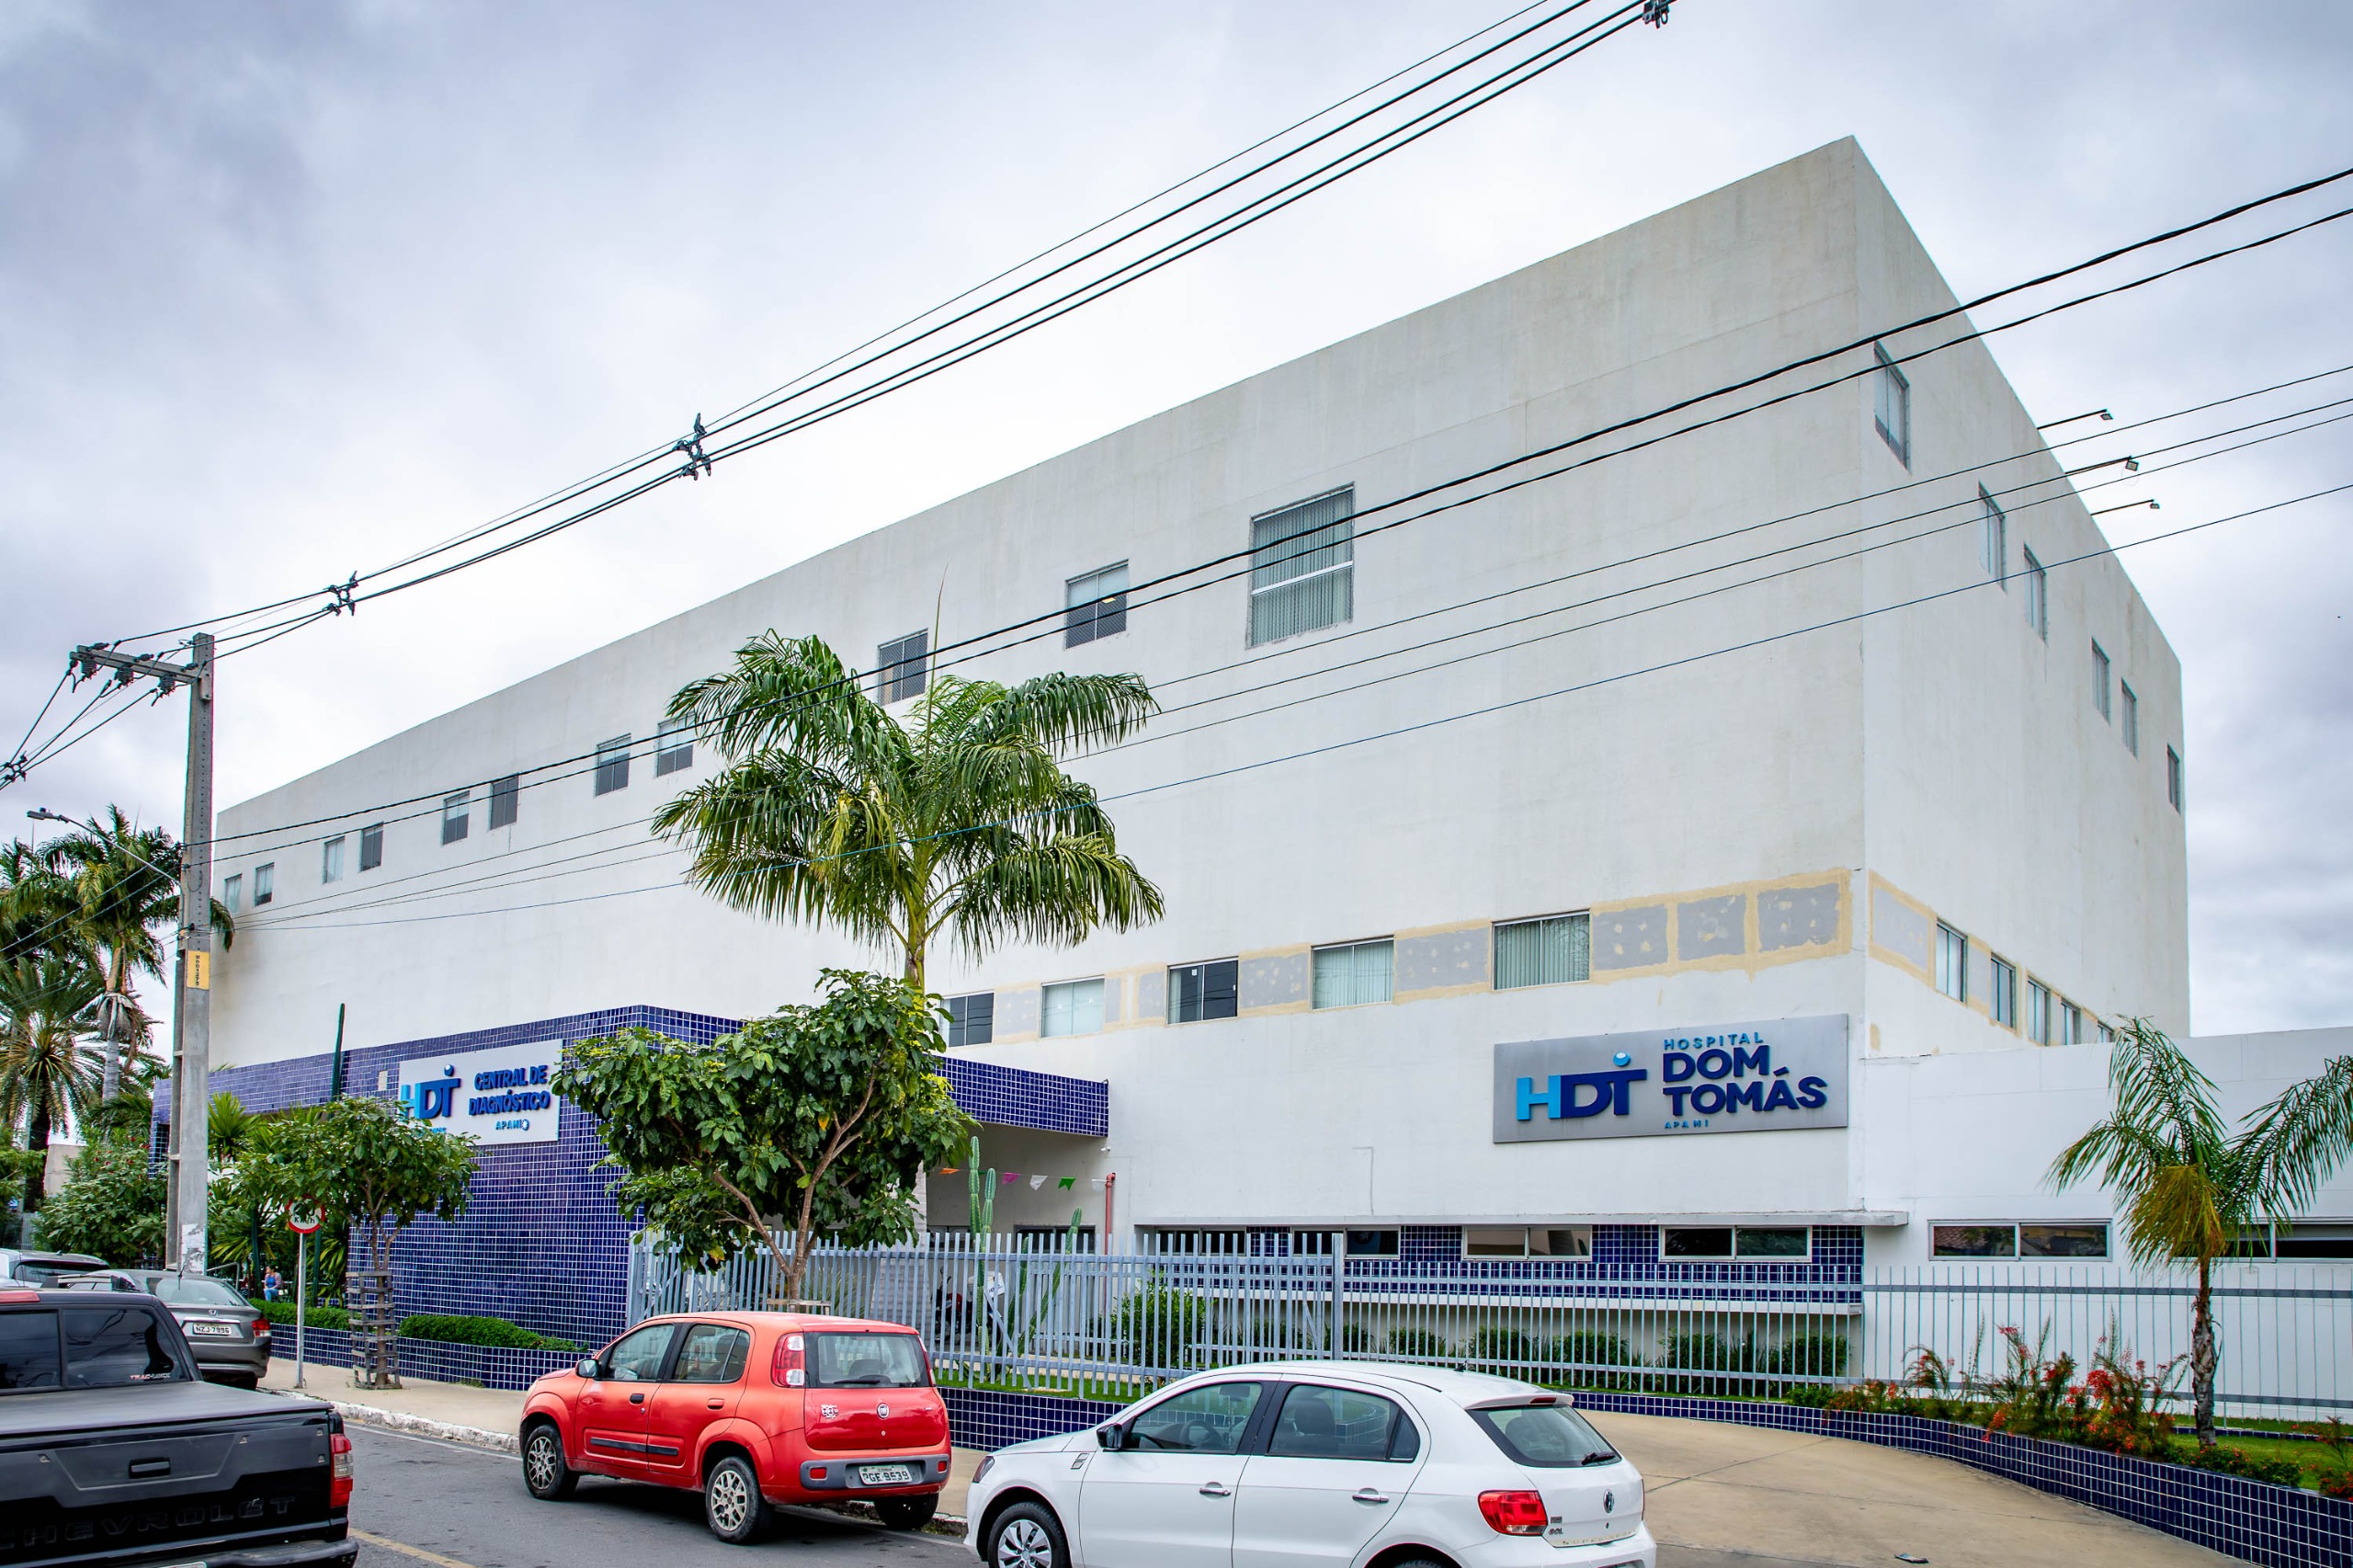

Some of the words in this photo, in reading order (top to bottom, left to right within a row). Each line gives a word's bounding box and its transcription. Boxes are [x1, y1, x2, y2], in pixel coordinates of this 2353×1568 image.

[1663, 1031, 1764, 1051] HOSPITAL
[1662, 1045, 1769, 1083] DOM
[474, 1068, 528, 1091] CENTRAL
[529, 1065, 548, 1085] DE
[400, 1077, 461, 1119] HDT
[469, 1089, 551, 1116] DIAGNÓSTICO
[1517, 1068, 1647, 1121] HDT
[1662, 1067, 1828, 1117] TOMÁS
[495, 1119, 522, 1131] APAMI
[1664, 1119, 1709, 1130] APAMI
